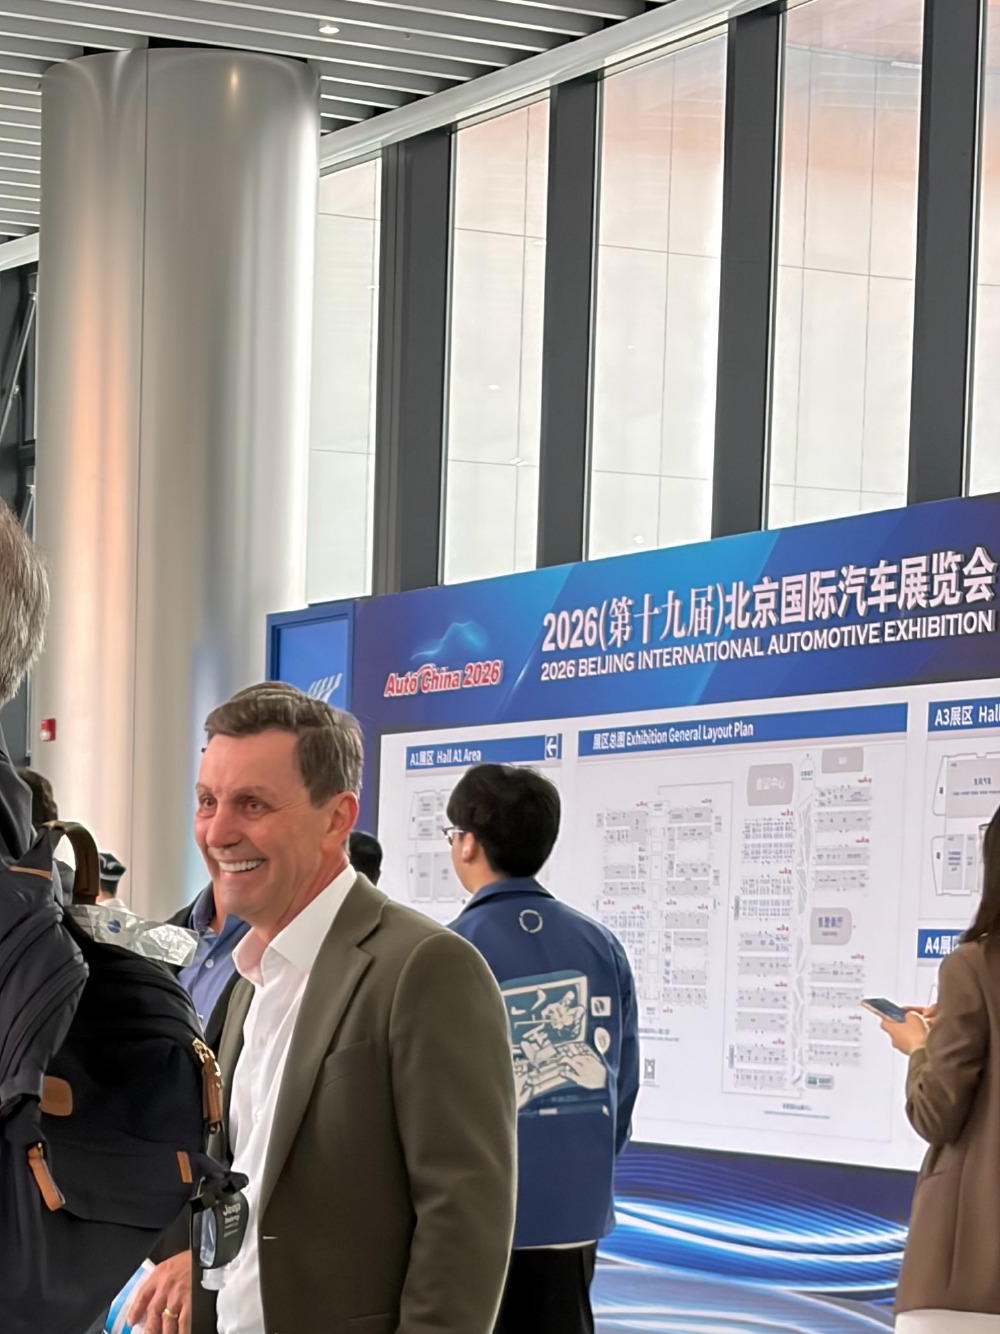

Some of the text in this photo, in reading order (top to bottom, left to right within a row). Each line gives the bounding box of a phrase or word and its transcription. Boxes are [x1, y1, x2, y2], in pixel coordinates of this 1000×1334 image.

[541, 546, 996, 652] 2026(第十九届)北京国际汽车展览会
[540, 609, 994, 682] 2026 BEIJING INTERNATIONAL AUTOMOTIVE EXHIBITION
[384, 659, 503, 697] Auto China 2026
[935, 705, 973, 727] A3展区
[626, 728, 668, 747] Exhibition
[669, 724, 702, 743] General
[703, 722, 733, 743] Layout
[734, 720, 754, 738] Plan
[436, 748, 453, 764] Hall
[463, 749, 482, 762] Area
